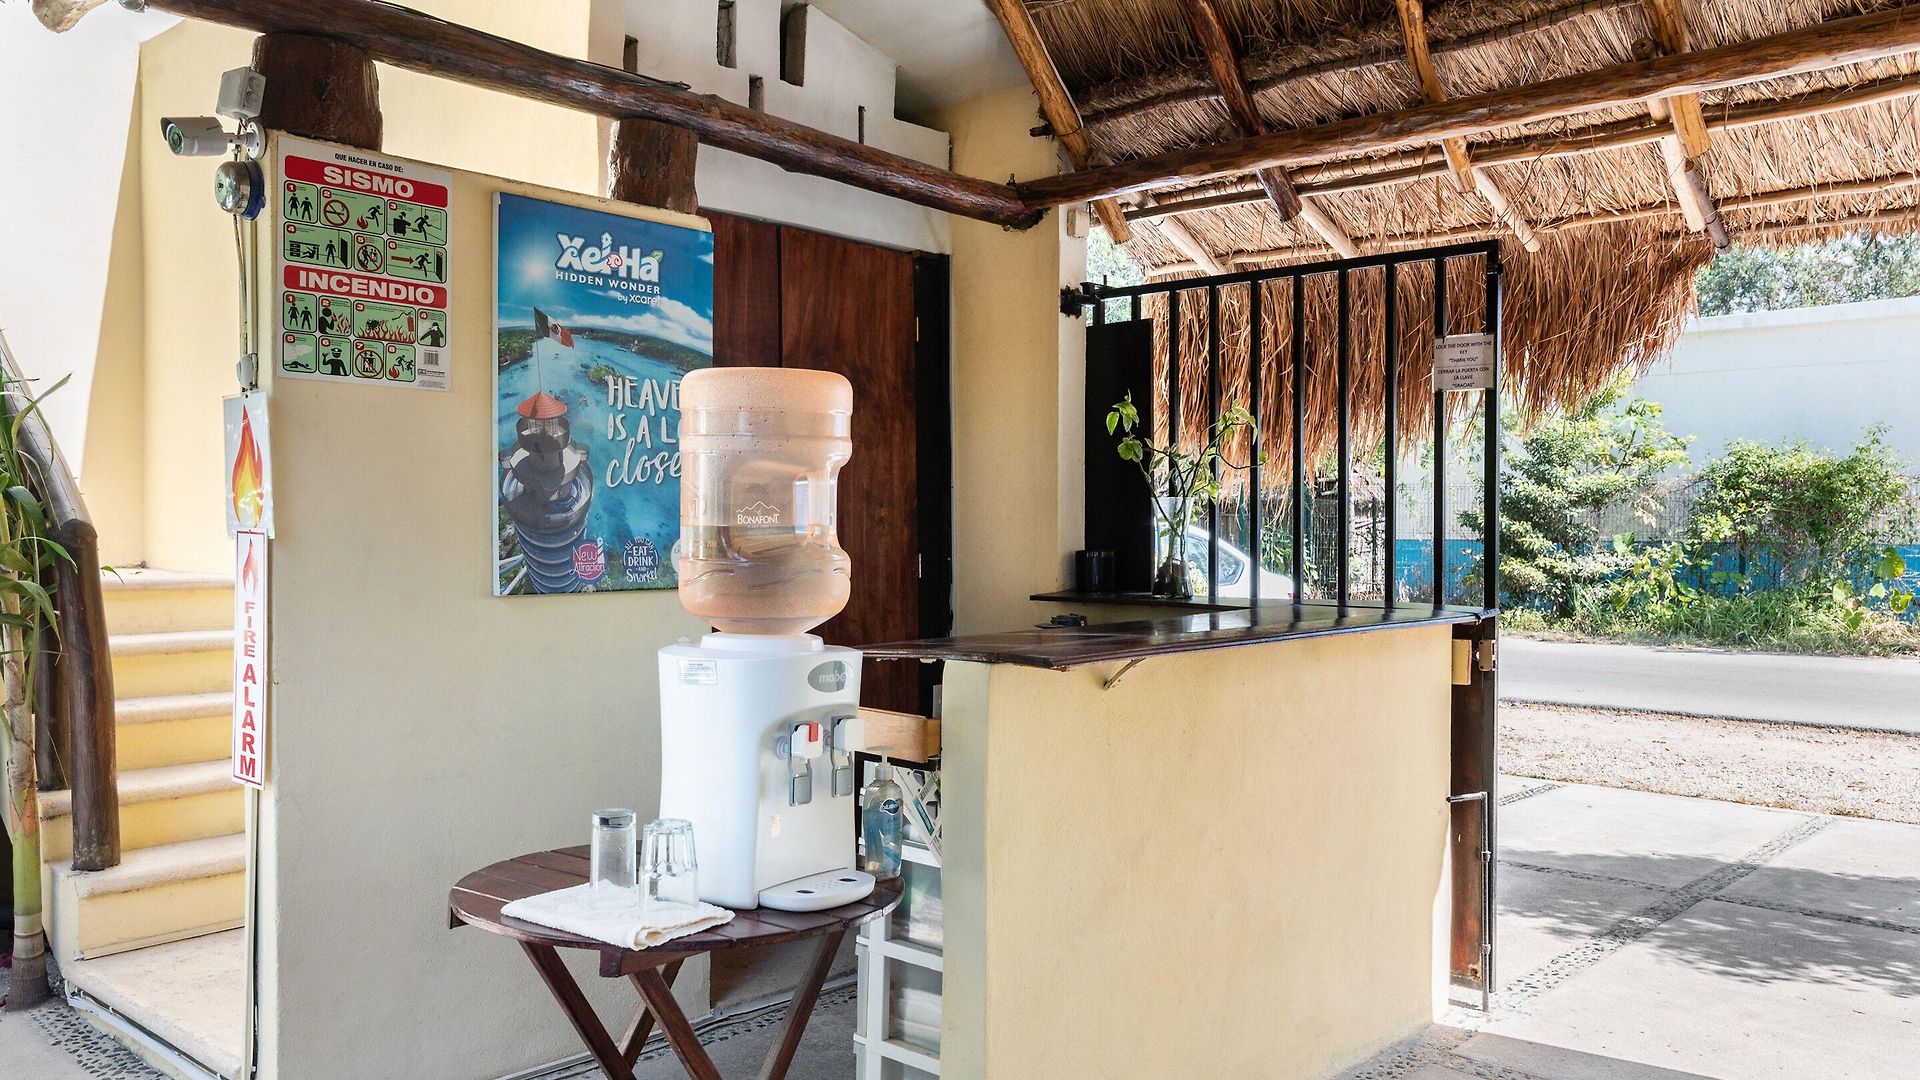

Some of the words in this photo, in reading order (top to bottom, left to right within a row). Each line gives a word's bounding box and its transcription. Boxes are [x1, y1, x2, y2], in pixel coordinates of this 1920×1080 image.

[334, 153, 347, 161] QUE
[348, 155, 368, 166] HACER
[368, 160, 377, 168] EN
[377, 162, 393, 171] CASO
[394, 165, 404, 173] DE:
[323, 165, 415, 198] SISMO
[299, 270, 435, 304] INCENDIO
[555, 271, 603, 286] HIDDEN
[608, 279, 660, 294] WONDER
[617, 292, 628, 304] by
[607, 412, 627, 441] IS
[636, 414, 652, 449] A
[737, 513, 779, 525] BONAFONT
[634, 535, 645, 544] YOU
[572, 545, 598, 562] New
[632, 546, 648, 556] EAT
[573, 560, 605, 574] Attraction
[627, 556, 655, 567] DRINK
[626, 567, 658, 583] Snorkel
[243, 601, 256, 658] FIRE
[818, 669, 846, 684] mabe
[240, 663, 257, 778] ALARM
